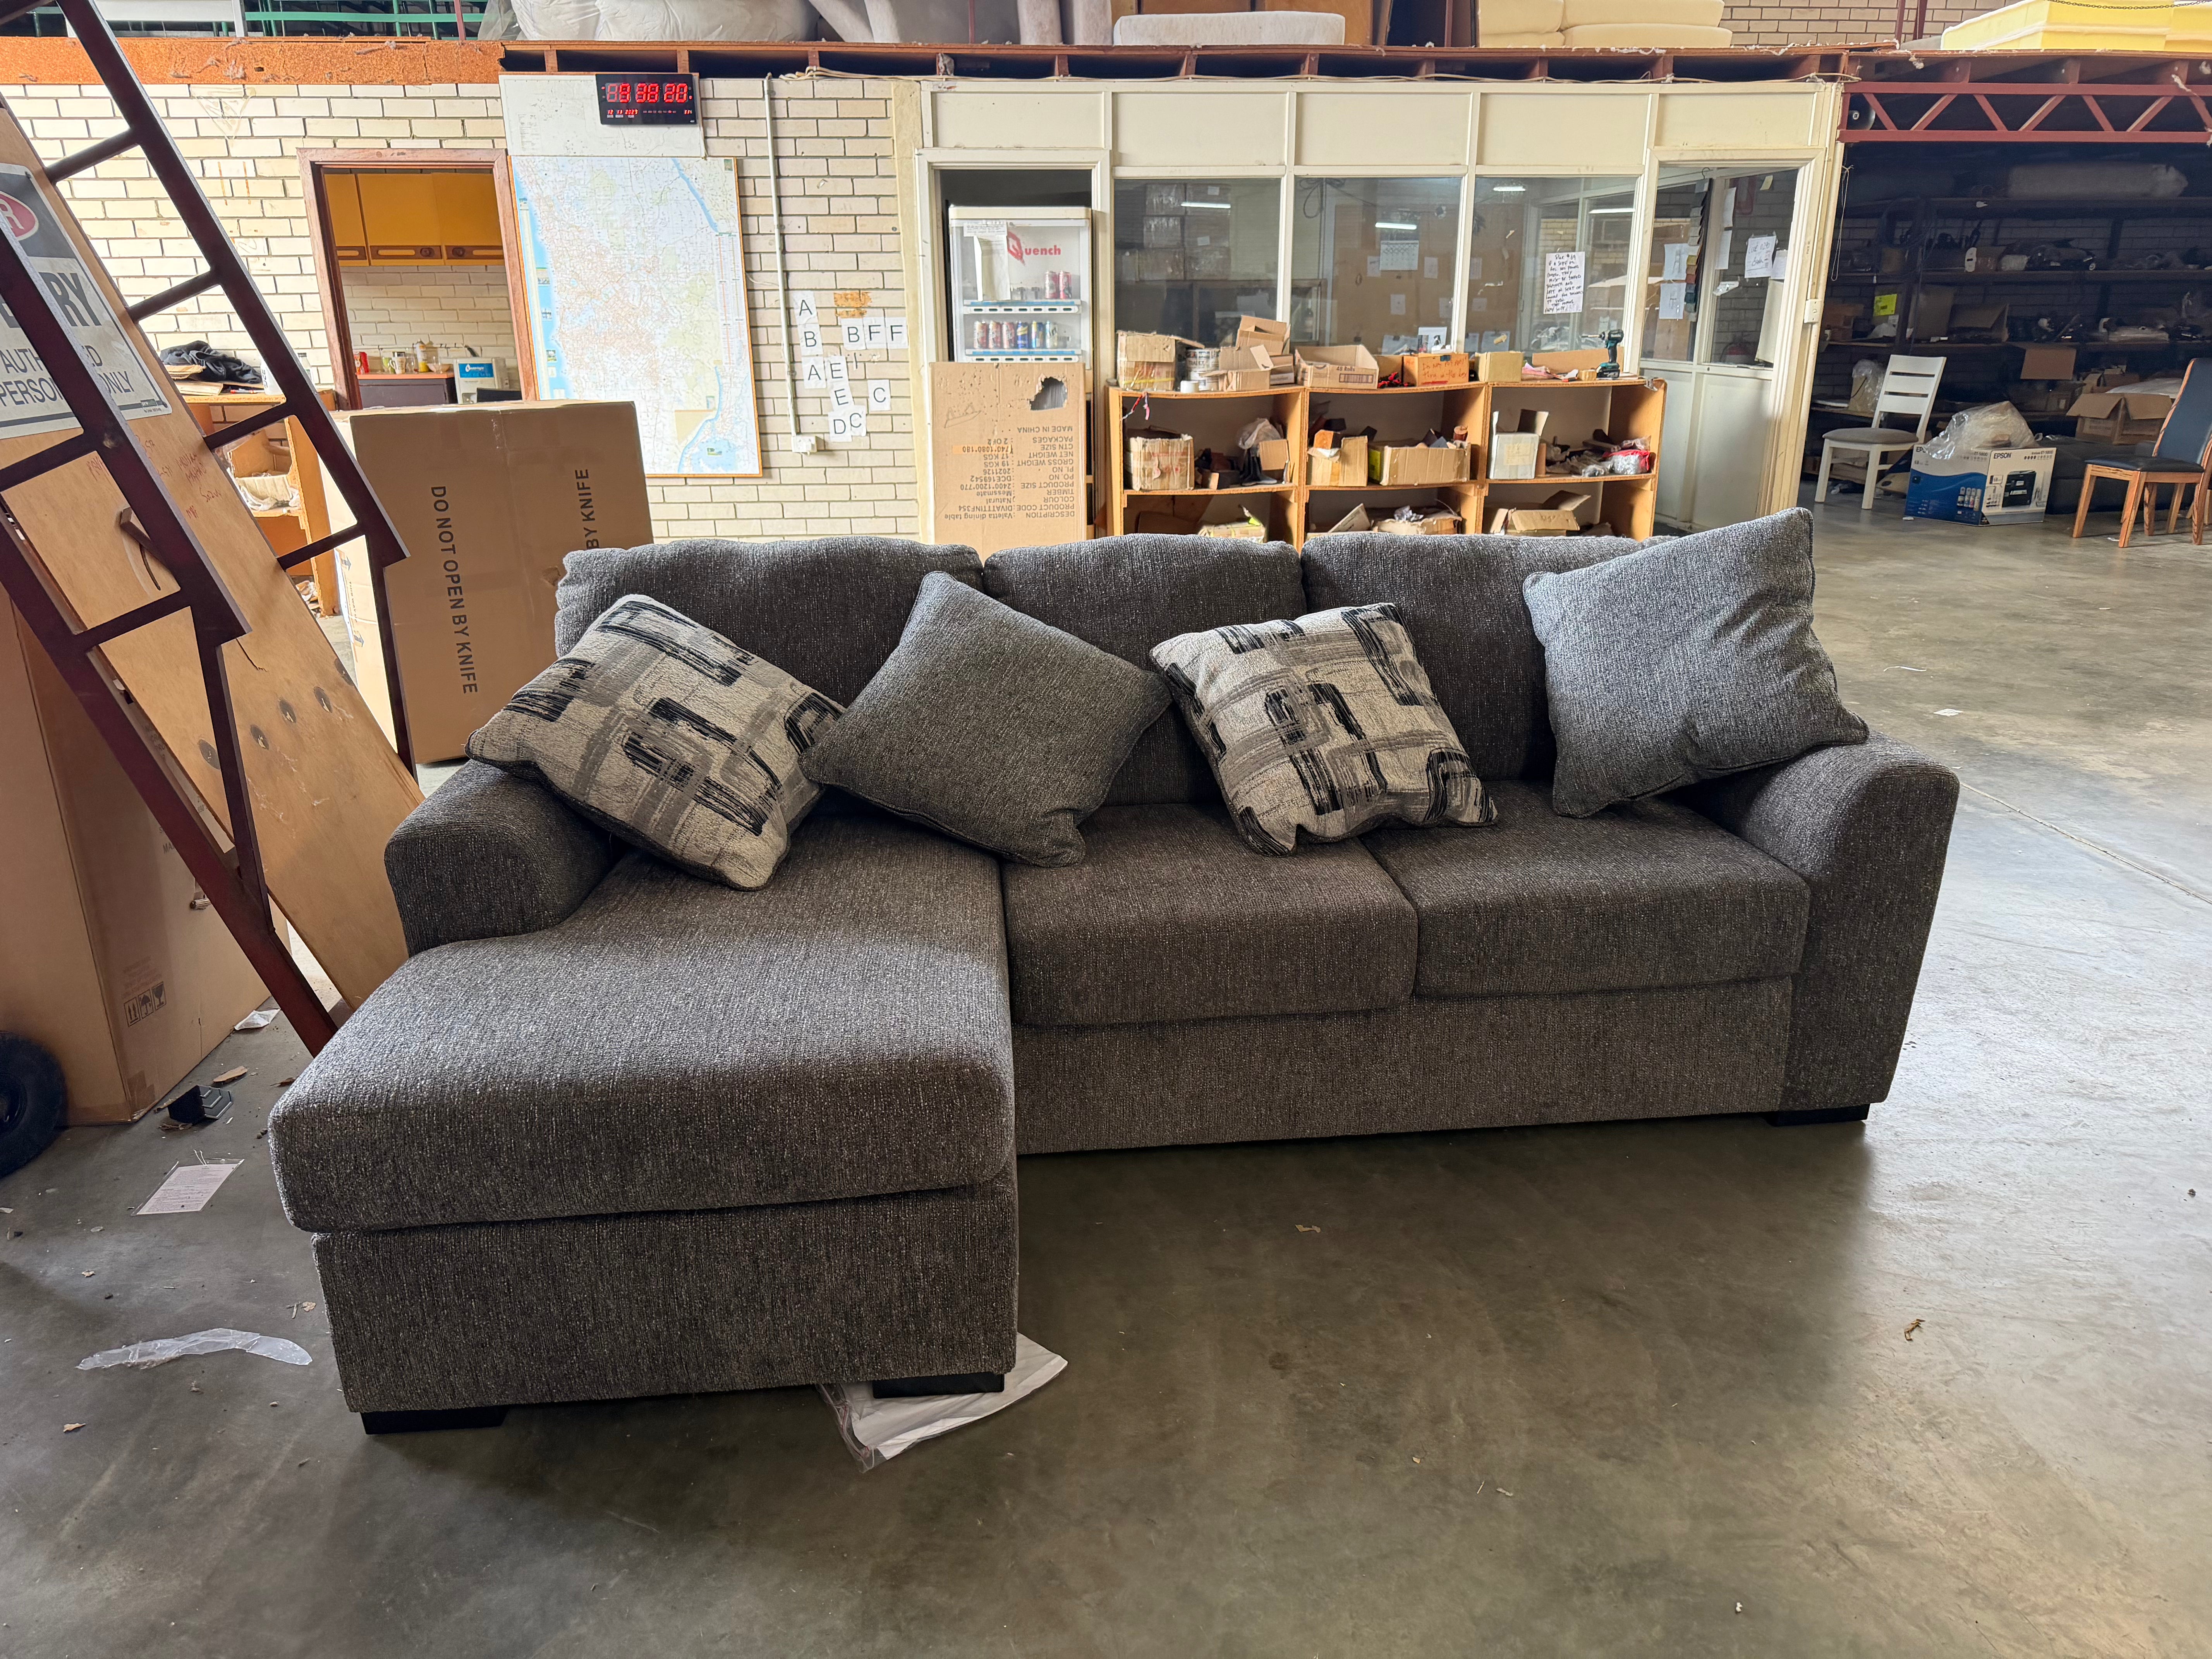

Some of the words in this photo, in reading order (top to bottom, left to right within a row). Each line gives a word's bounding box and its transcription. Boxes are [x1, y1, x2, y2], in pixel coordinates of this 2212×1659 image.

[799, 299, 813, 316] A
[804, 331, 817, 347] B
[808, 364, 822, 381] A
[830, 362, 843, 379] E
[834, 388, 848, 406] E
[873, 387, 886, 403] C
[833, 419, 846, 434] D
[849, 412, 862, 428] C
[431, 486, 450, 513] DO
[575, 468, 596, 522] KNIFE
[436, 517, 457, 556] NOT
[583, 527, 599, 550] BY
[443, 560, 465, 610] OPEN
[452, 614, 469, 637] BY
[456, 641, 478, 695] KNIFE
